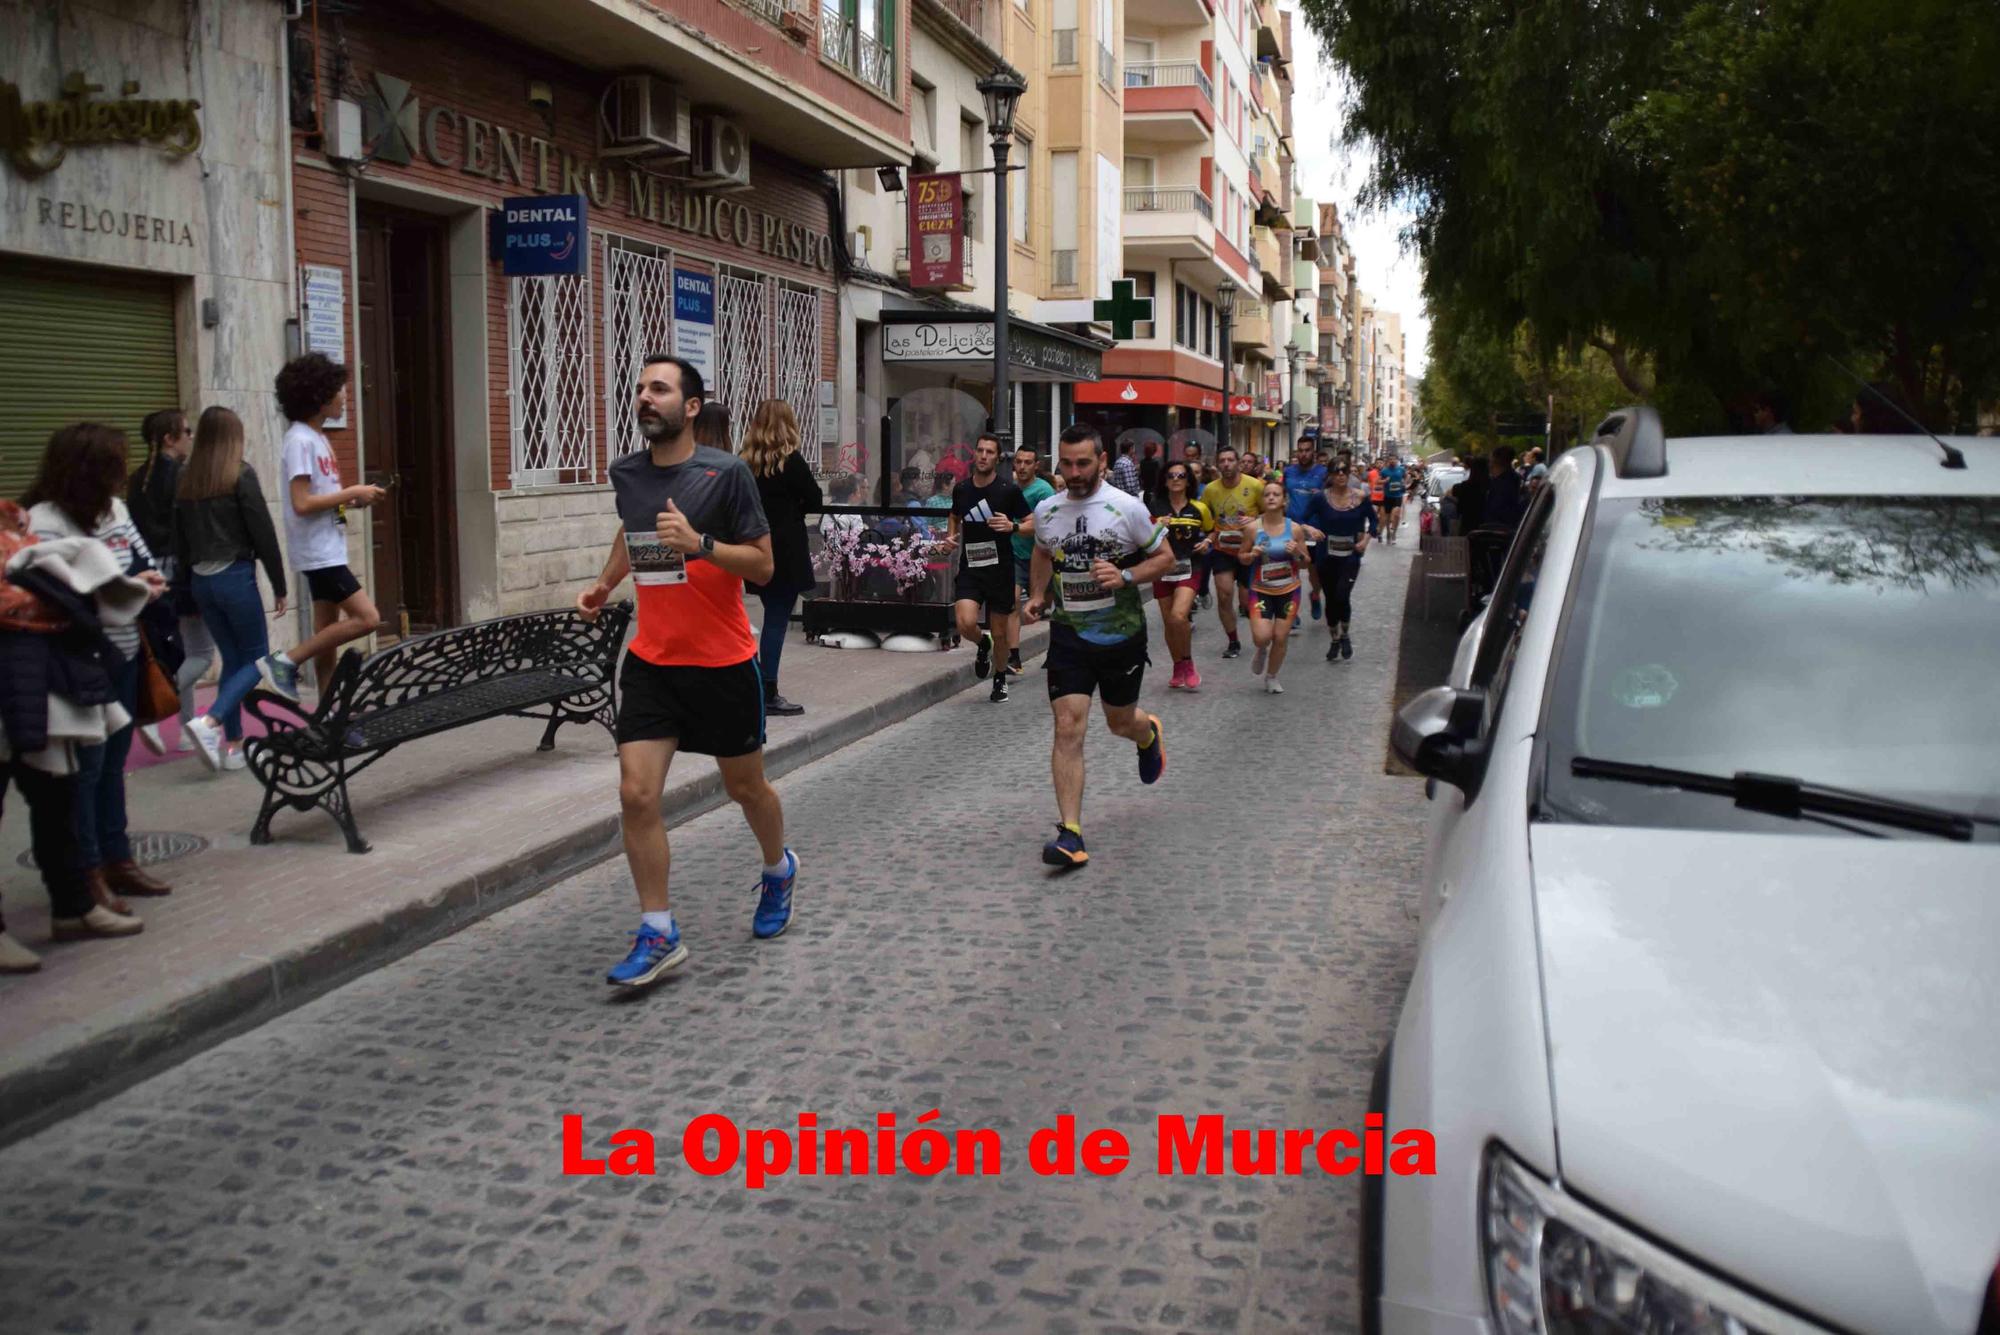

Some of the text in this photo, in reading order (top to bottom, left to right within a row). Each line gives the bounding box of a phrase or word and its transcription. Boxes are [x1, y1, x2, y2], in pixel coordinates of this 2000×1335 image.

[425, 106, 614, 208] CENTRO
[760, 213, 832, 271] PASEO
[37, 196, 195, 248] RELOJERIA
[507, 207, 576, 223] DENTAL
[506, 233, 551, 249] PLUS
[677, 276, 711, 295] DENTAL
[677, 297, 701, 312] PLUS
[885, 327, 911, 355] Las
[915, 325, 995, 347] Delicias
